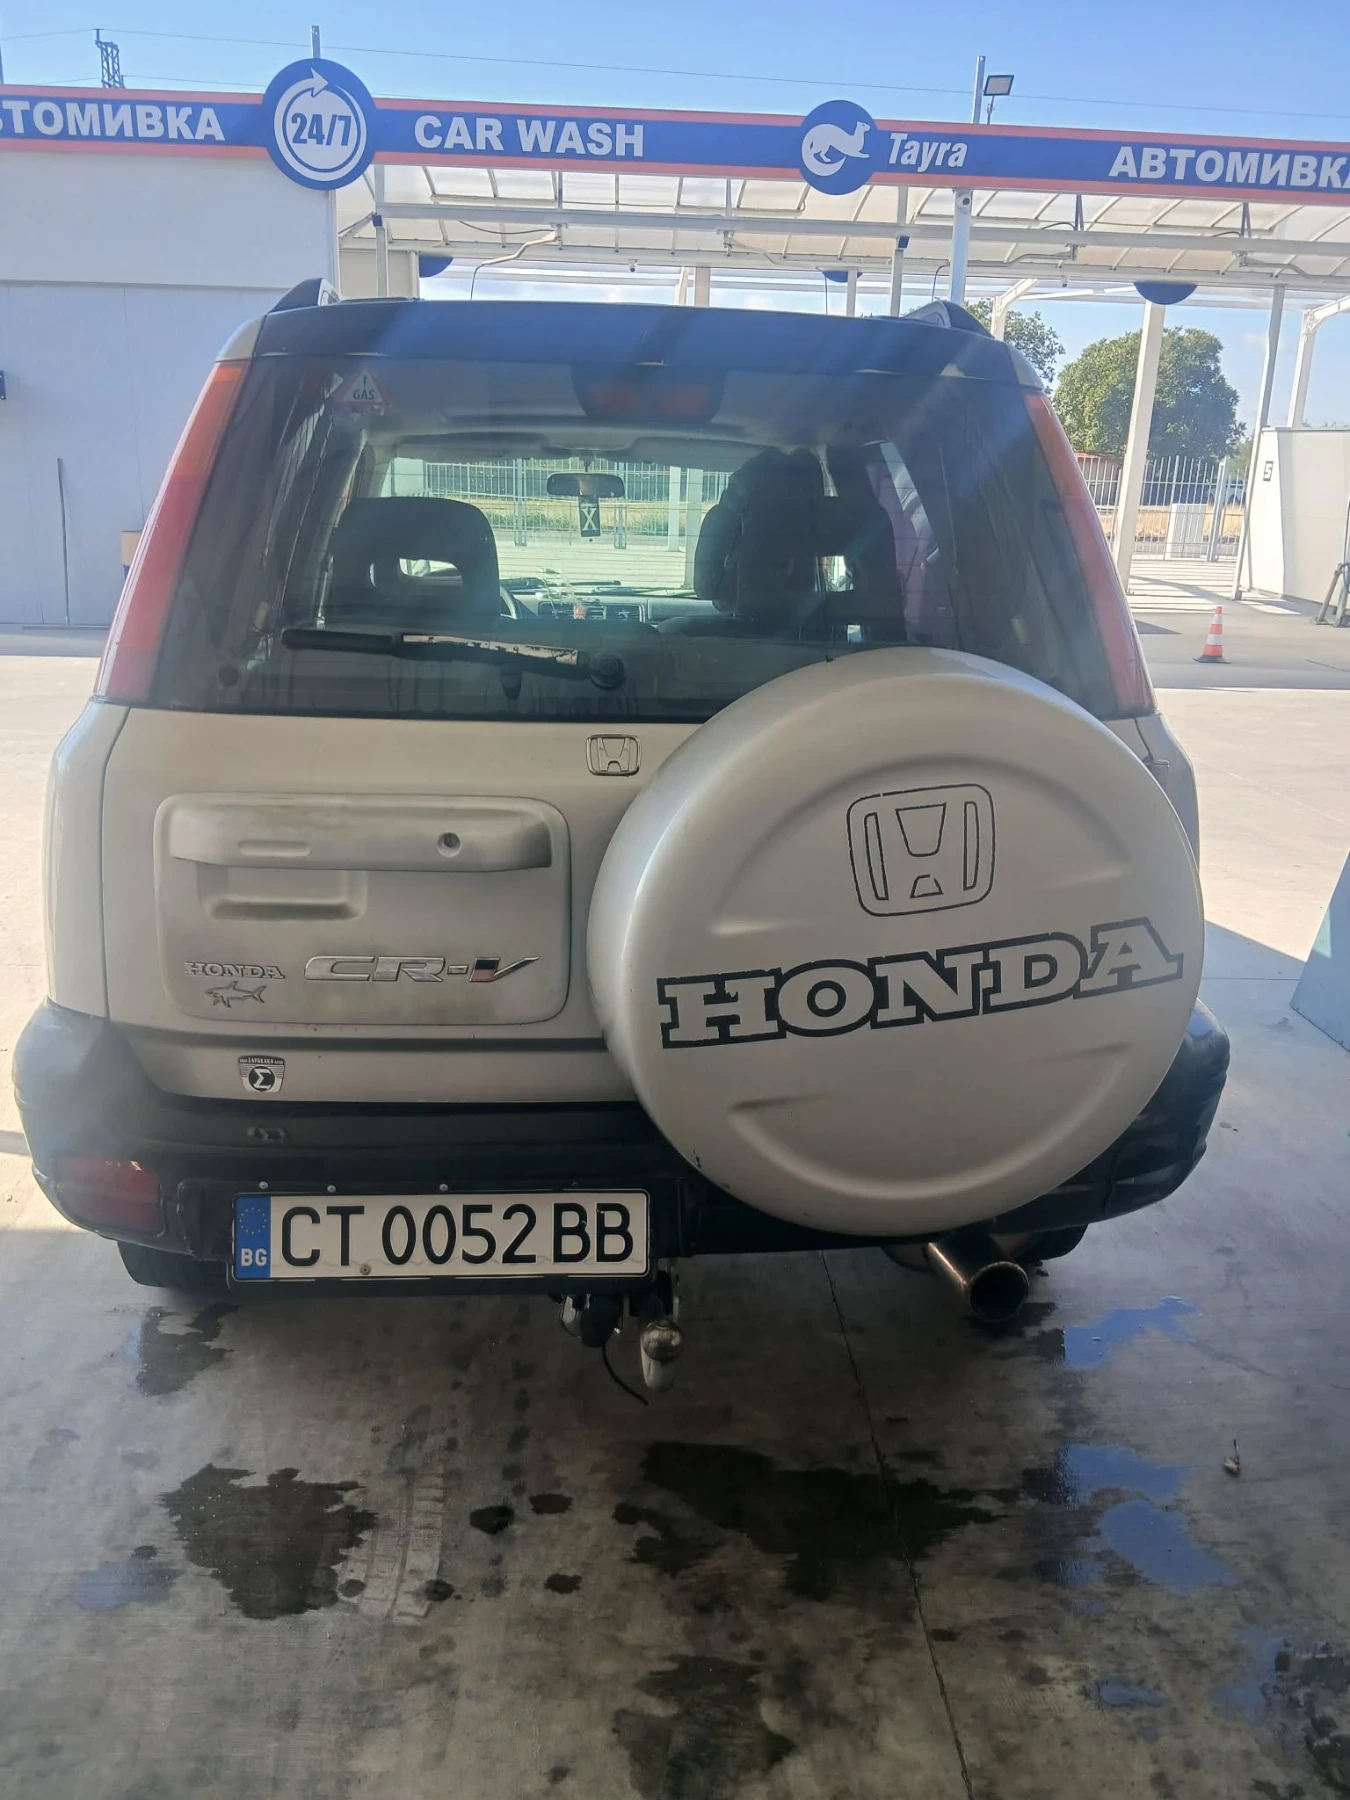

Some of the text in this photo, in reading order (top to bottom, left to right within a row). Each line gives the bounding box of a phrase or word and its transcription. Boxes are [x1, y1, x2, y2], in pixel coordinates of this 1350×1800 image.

[0, 100, 225, 141] ТОМИВКА
[291, 114, 355, 147] 24/7
[415, 115, 645, 157] CAR WASH
[889, 132, 968, 172] Tayra
[1109, 146, 1350, 188] АВТОМИВК
[353, 389, 375, 400] GAS
[183, 955, 541, 983] HONDA CR-V
[657, 917, 1184, 1048] HONDA
[281, 1201, 635, 1267] CT 0052 BB
[240, 1248, 268, 1267] BG
